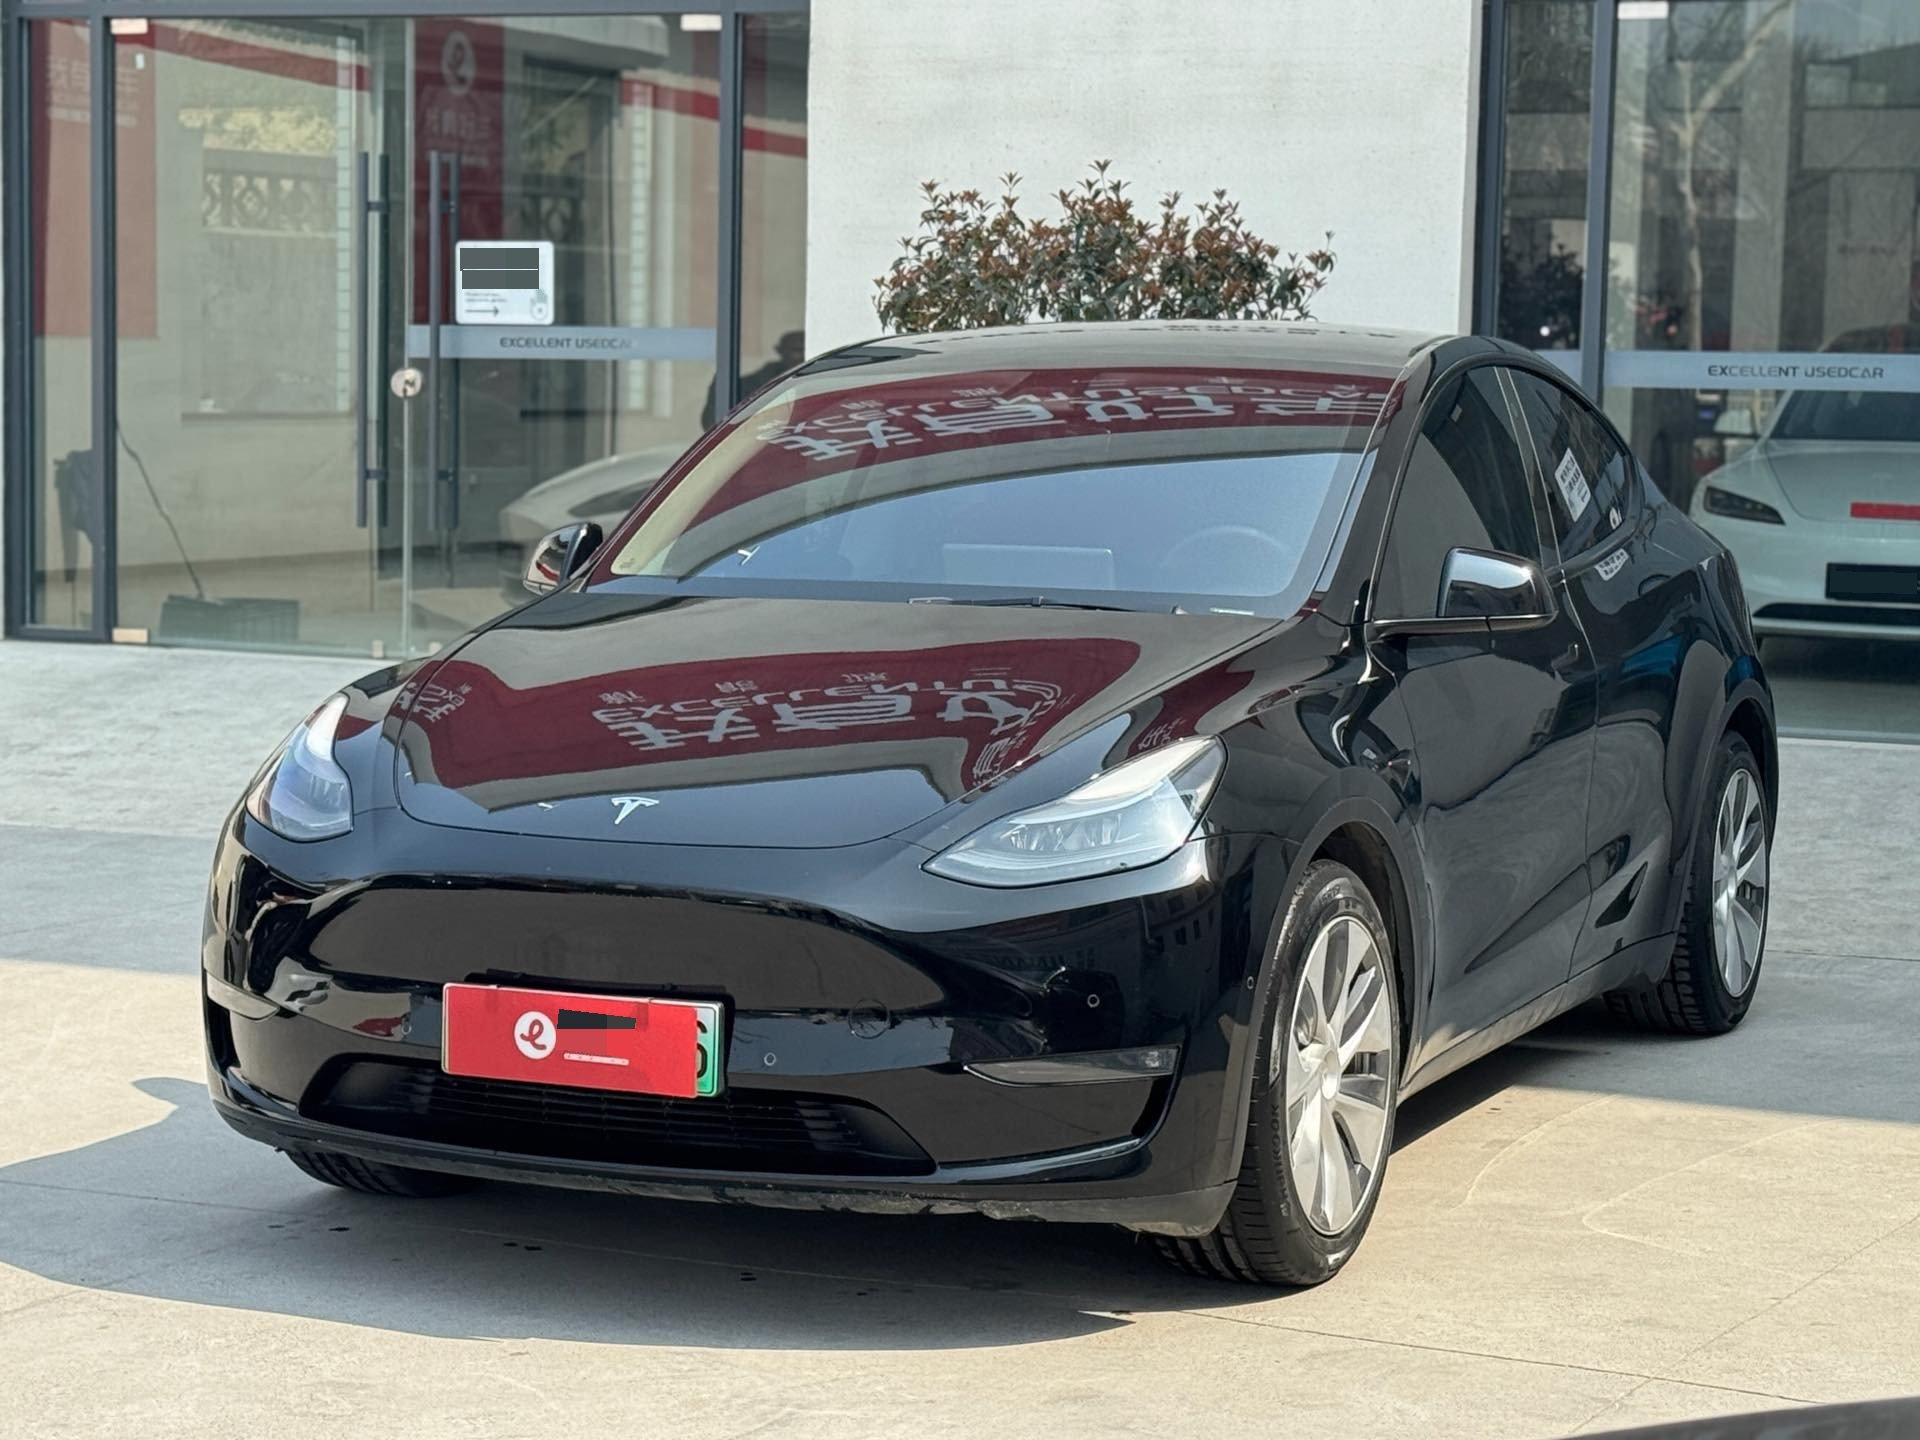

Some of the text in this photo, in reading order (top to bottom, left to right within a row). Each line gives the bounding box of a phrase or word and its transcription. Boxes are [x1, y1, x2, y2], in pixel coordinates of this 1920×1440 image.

[500, 337, 571, 349] EXCELLENT
[1708, 365, 1885, 378] EXCELLENT USEDCAR
